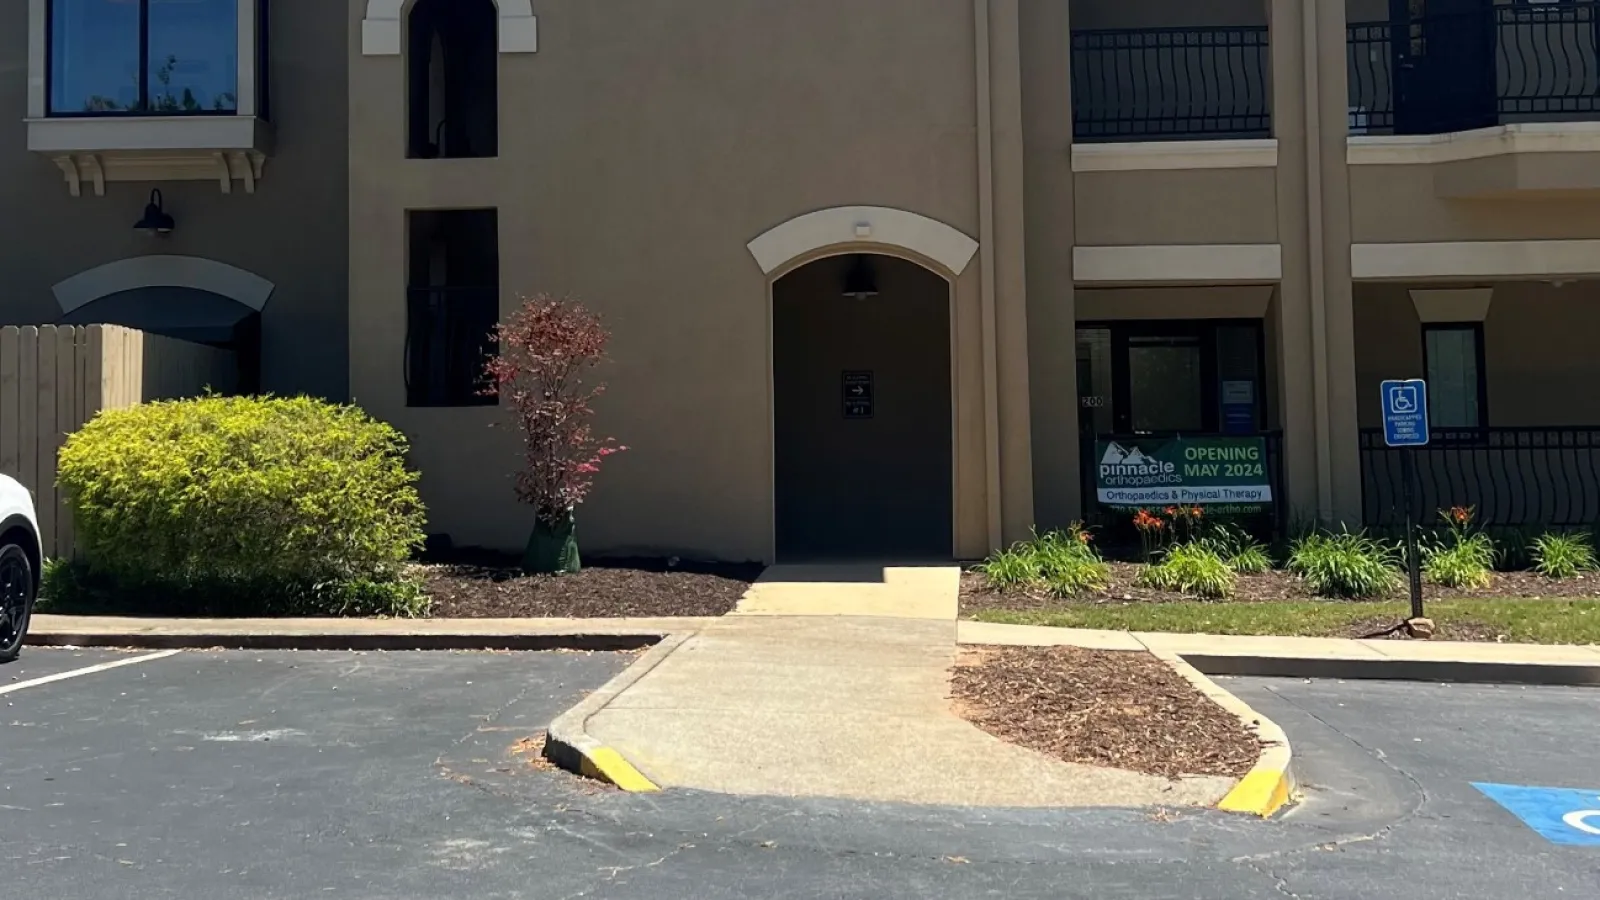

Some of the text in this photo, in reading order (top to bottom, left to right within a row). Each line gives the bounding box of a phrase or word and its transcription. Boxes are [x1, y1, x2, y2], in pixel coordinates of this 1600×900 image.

[1184, 447, 1259, 461] OPENING
[1100, 460, 1175, 478] pinnacle
[1184, 463, 1264, 477] MAY 2024
[1105, 472, 1183, 486] orthopaedics
[1106, 488, 1262, 501] Orthopaedics & Physical Therapy
